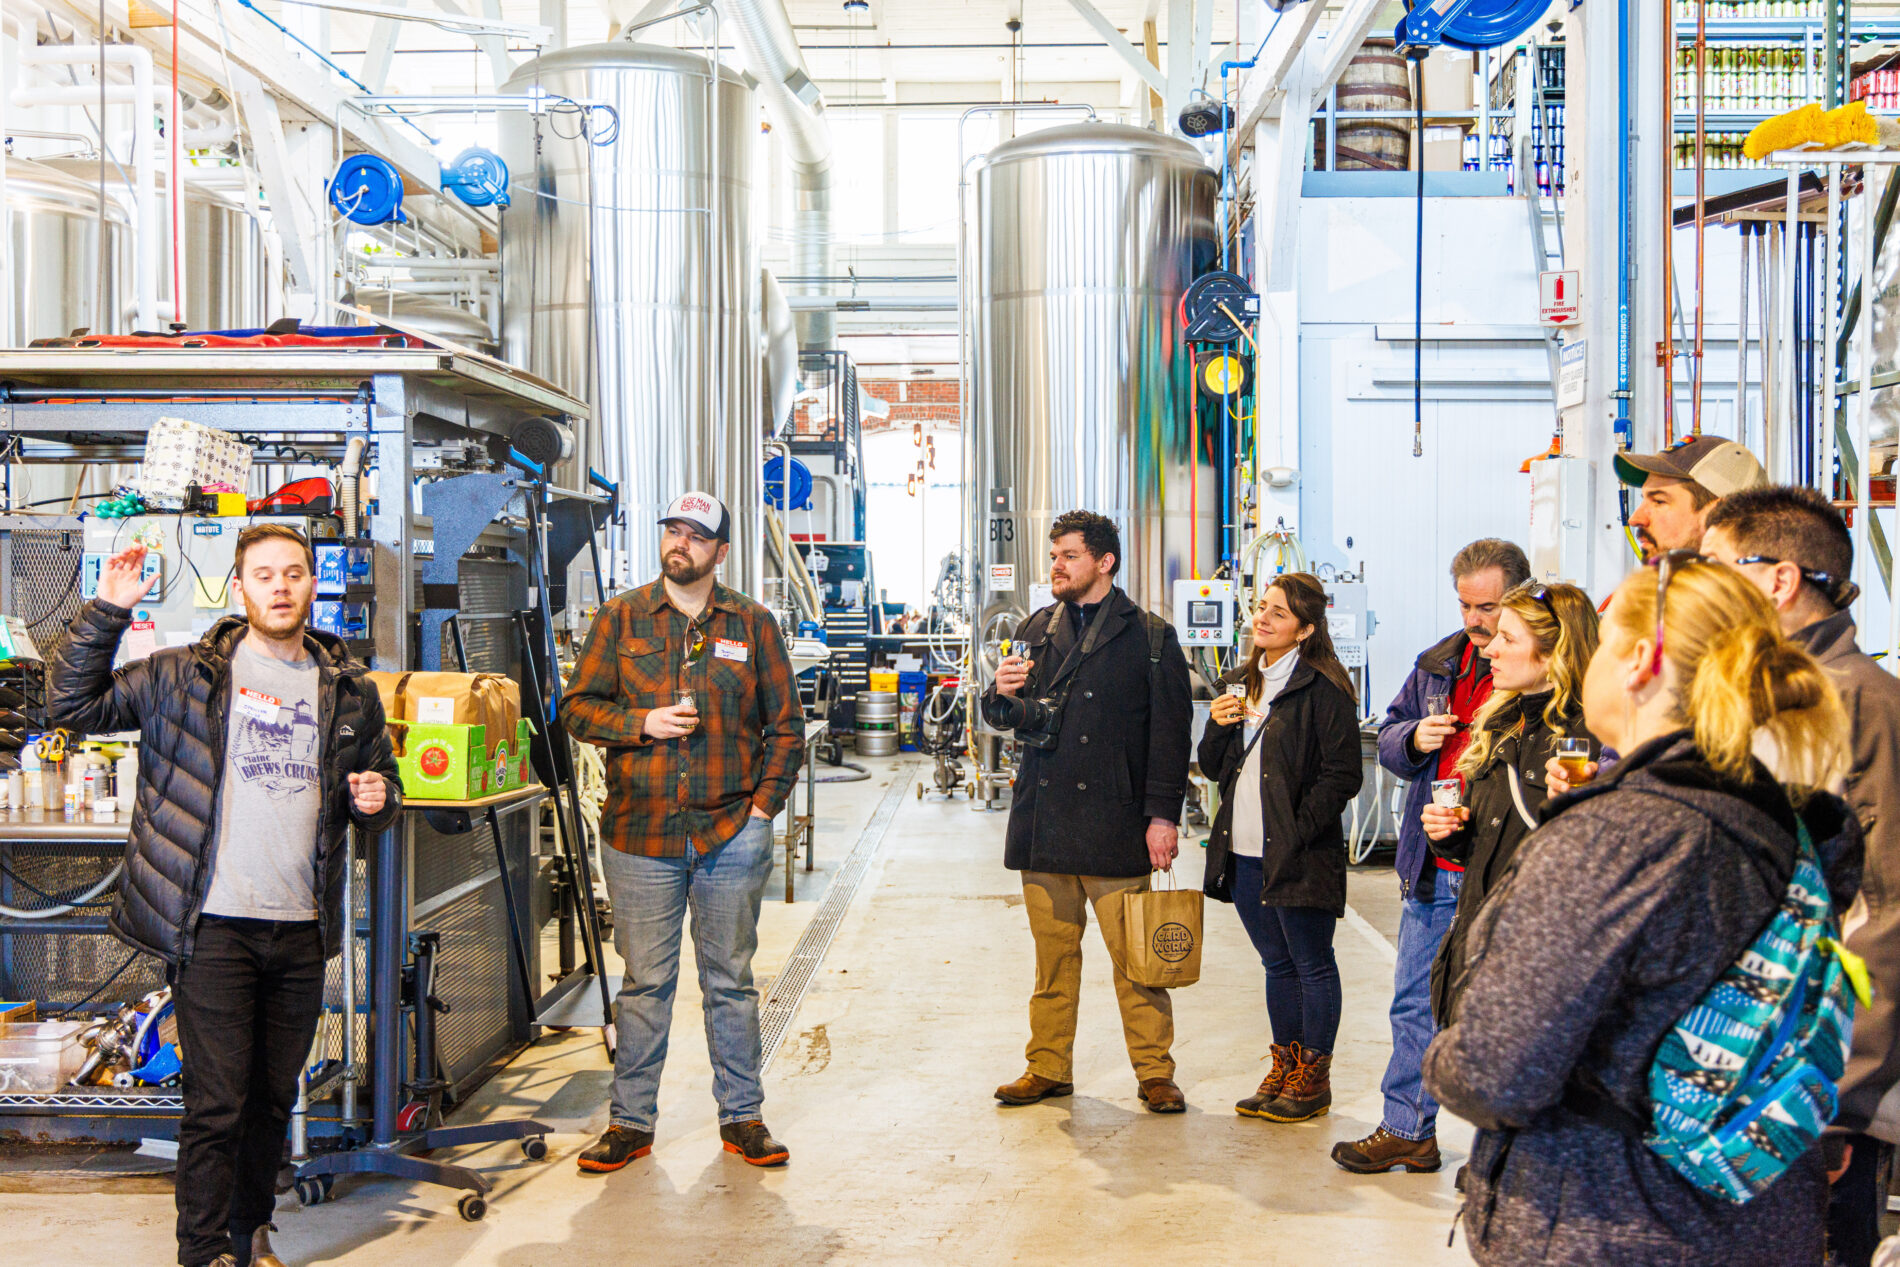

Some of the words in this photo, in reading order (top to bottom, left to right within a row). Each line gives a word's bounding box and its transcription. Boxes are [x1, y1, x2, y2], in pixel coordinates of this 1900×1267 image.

[1542, 306, 1577, 314] EXTINGUISHER
[1562, 343, 1584, 363] NOTICE
[990, 518, 1014, 542] BT3
[720, 638, 743, 647] HELLO
[246, 689, 276, 704] HELLO
[243, 754, 271, 764] Maine
[1157, 931, 1188, 942] CARD
[1153, 941, 1194, 953] WORKS
